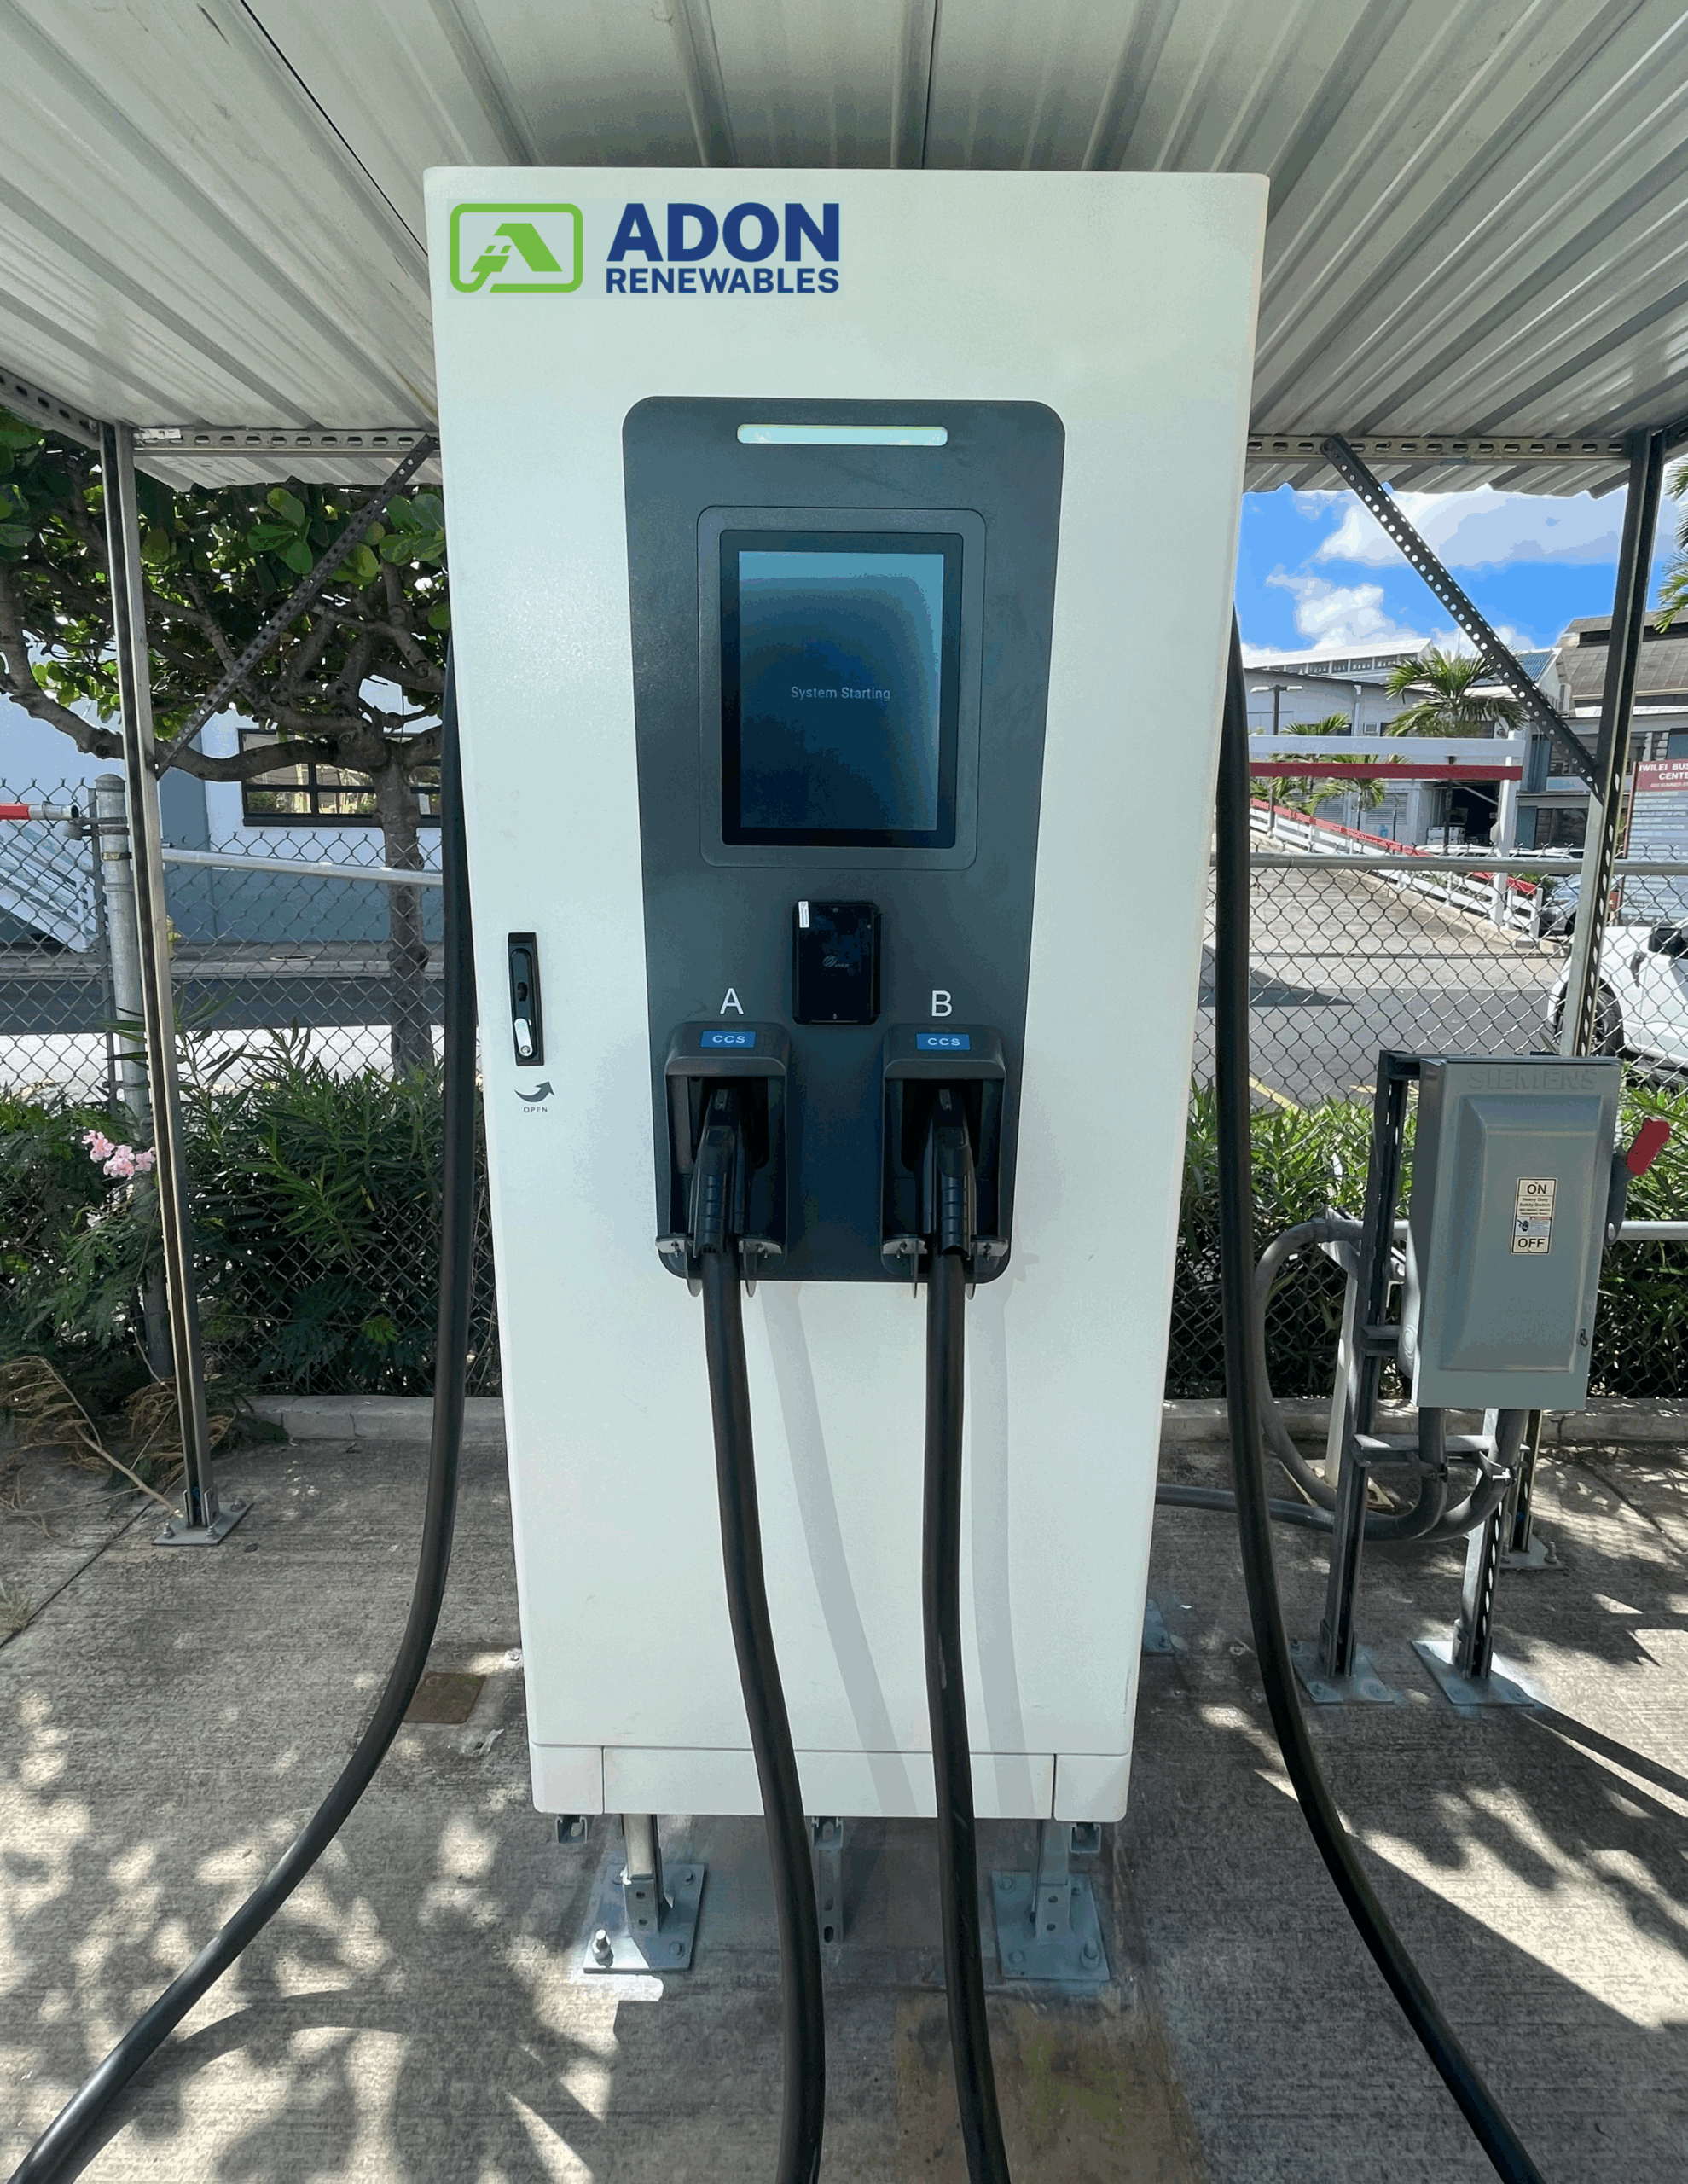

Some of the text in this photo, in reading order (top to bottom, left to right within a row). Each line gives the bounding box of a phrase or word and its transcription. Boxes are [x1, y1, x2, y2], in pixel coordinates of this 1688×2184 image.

[790, 686, 890, 702] System Starting
[719, 987, 745, 1015] A
[931, 990, 953, 1017] B
[711, 1035, 745, 1043] CCS
[927, 1037, 960, 1046] CCS
[1466, 1068, 1598, 1090] SIEMENS
[1527, 1183, 1546, 1194] ON
[1517, 1238, 1545, 1248] OFF
